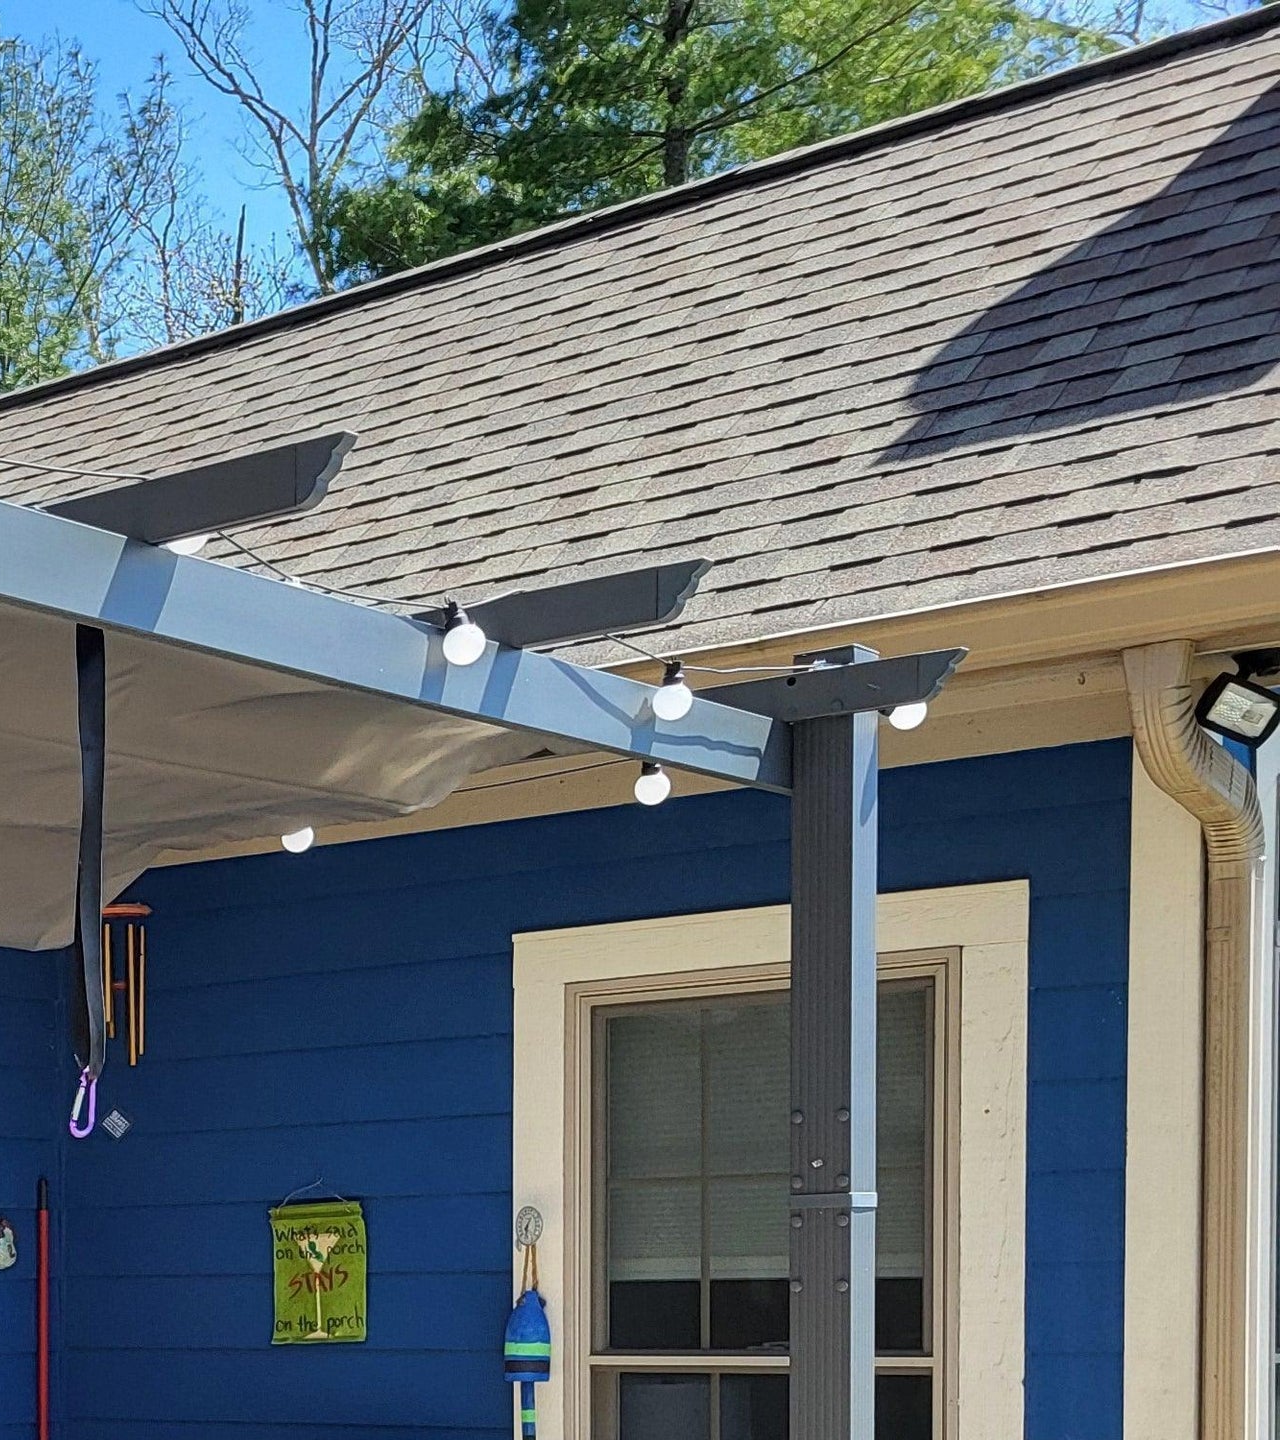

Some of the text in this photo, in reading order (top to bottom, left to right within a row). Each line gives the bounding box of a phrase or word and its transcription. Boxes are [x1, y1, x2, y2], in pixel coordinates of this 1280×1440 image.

[326, 1222, 358, 1238] said
[275, 1239, 365, 1264] on th porch
[288, 1263, 348, 1300] STAYS
[275, 1305, 364, 1338] on the porch
